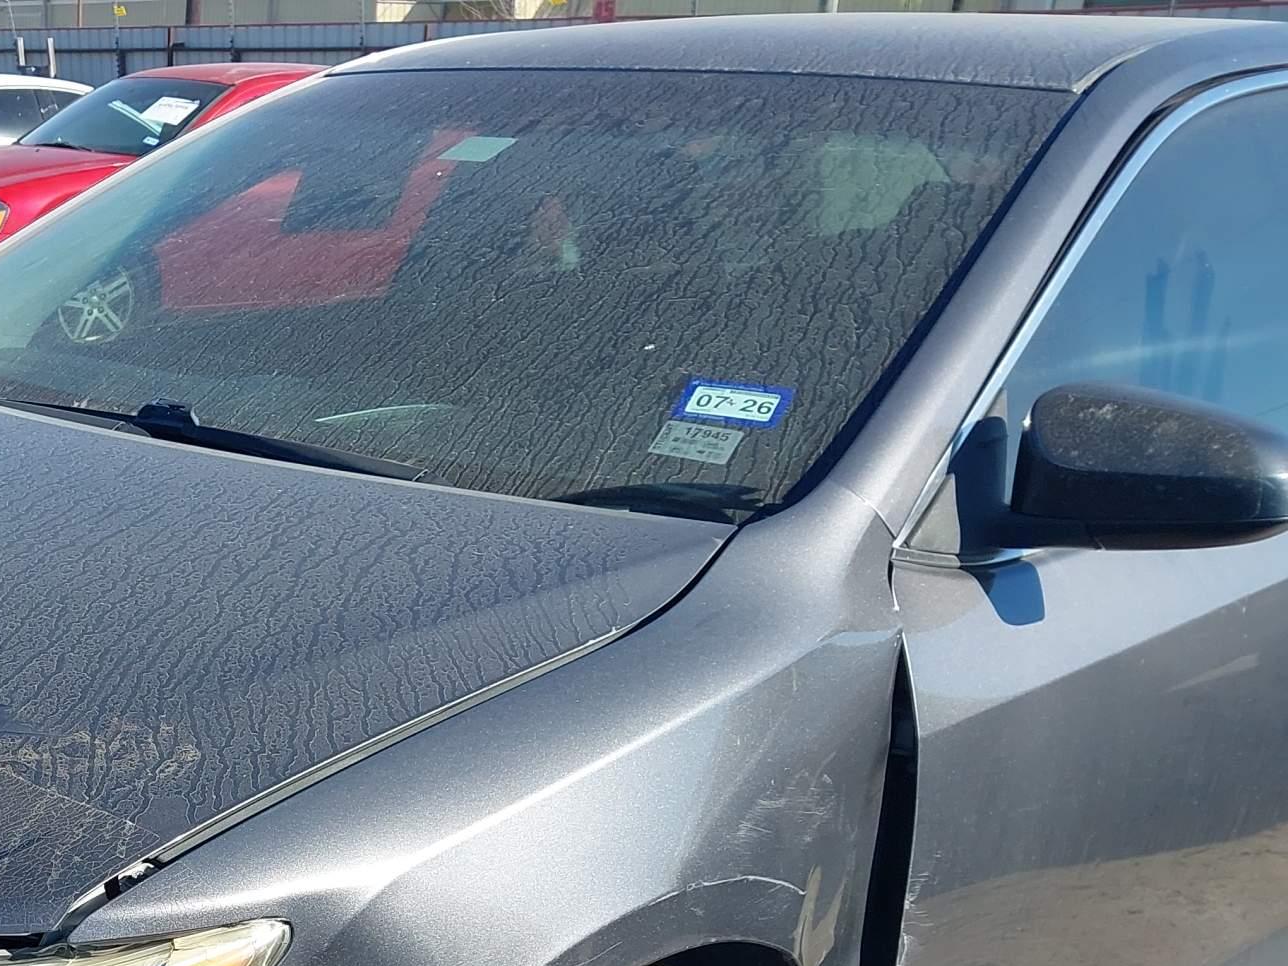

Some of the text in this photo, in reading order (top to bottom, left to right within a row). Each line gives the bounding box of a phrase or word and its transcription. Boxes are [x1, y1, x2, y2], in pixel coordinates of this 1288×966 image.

[696, 394, 774, 415] 07 26
[686, 427, 731, 442] 17945
